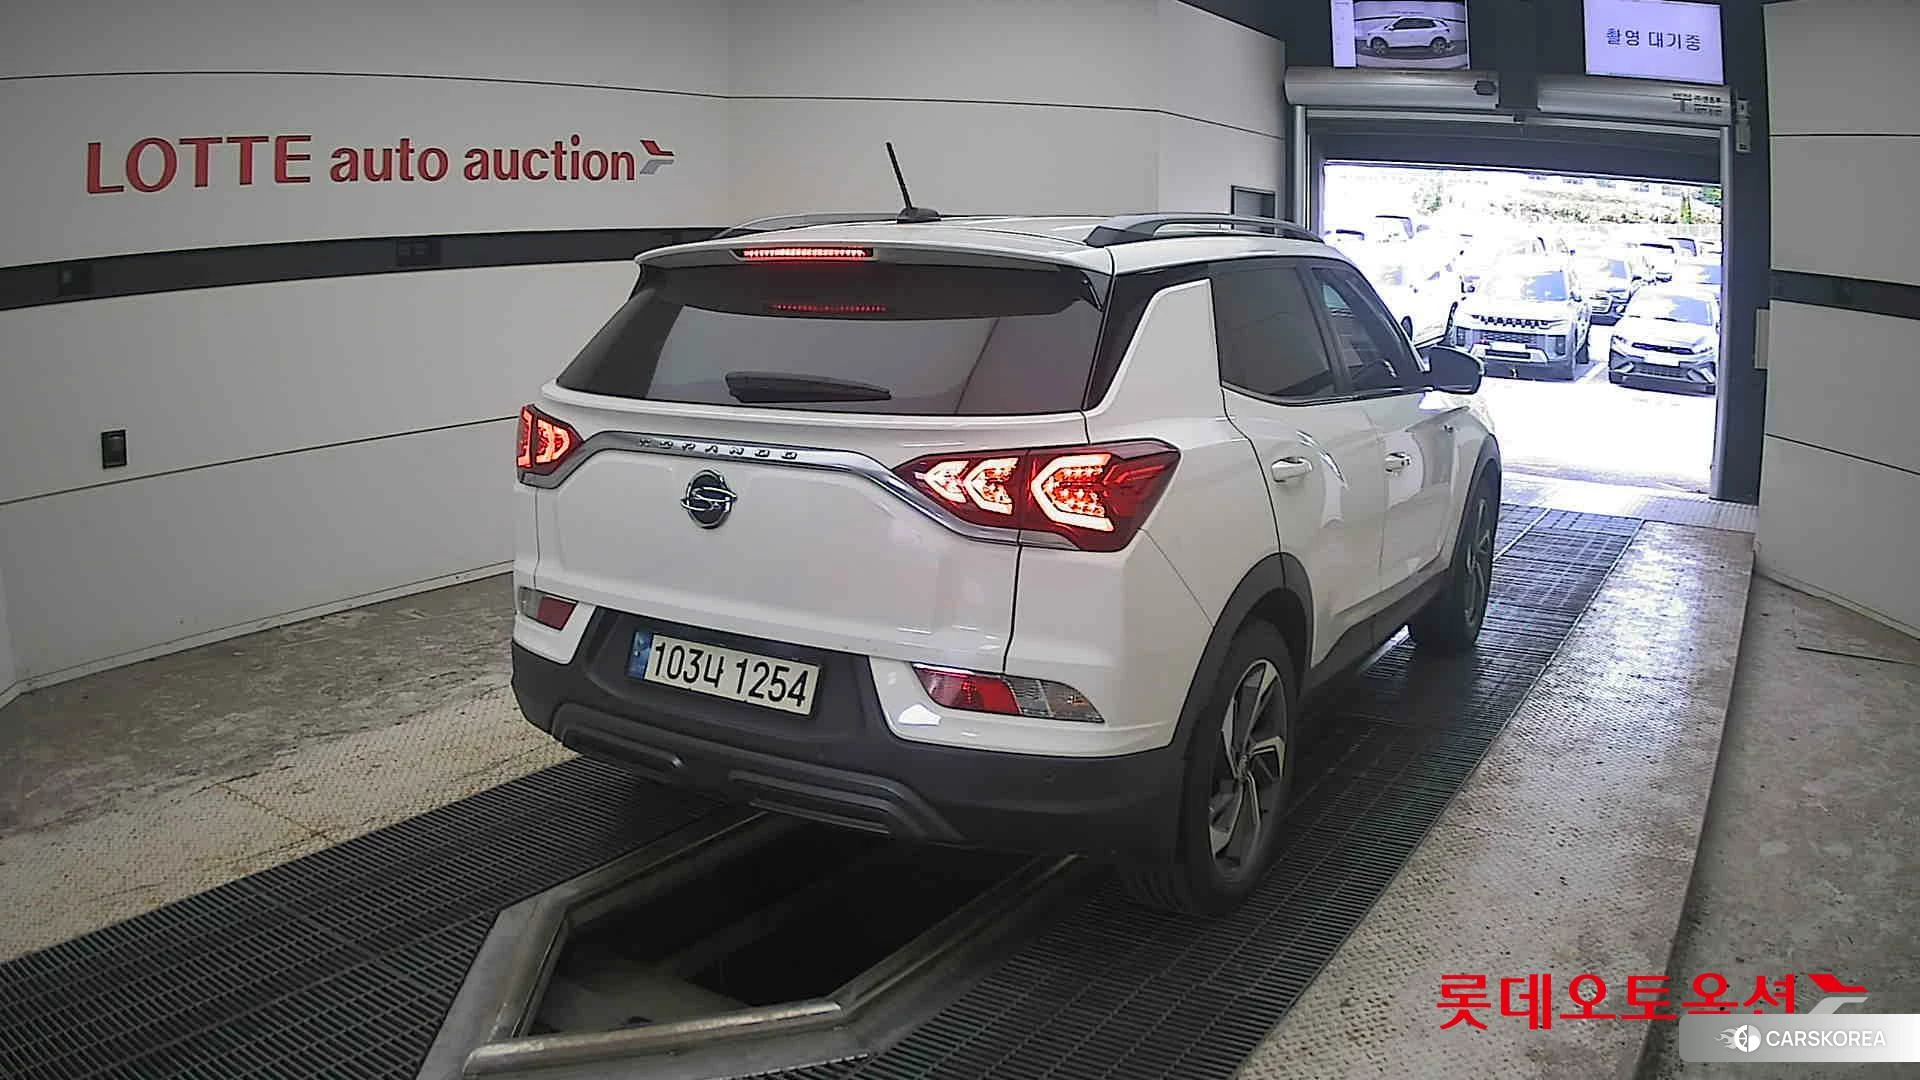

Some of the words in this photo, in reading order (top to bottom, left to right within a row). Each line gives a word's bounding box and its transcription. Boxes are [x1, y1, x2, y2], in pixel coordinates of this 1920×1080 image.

[1607, 27, 1640, 47] 촬영
[1648, 31, 1701, 51] 대기중
[87, 135, 311, 194] LOTTE
[330, 138, 448, 182] auto
[463, 134, 635, 181] auction
[655, 642, 724, 688] 103나
[736, 658, 808, 707] 1254
